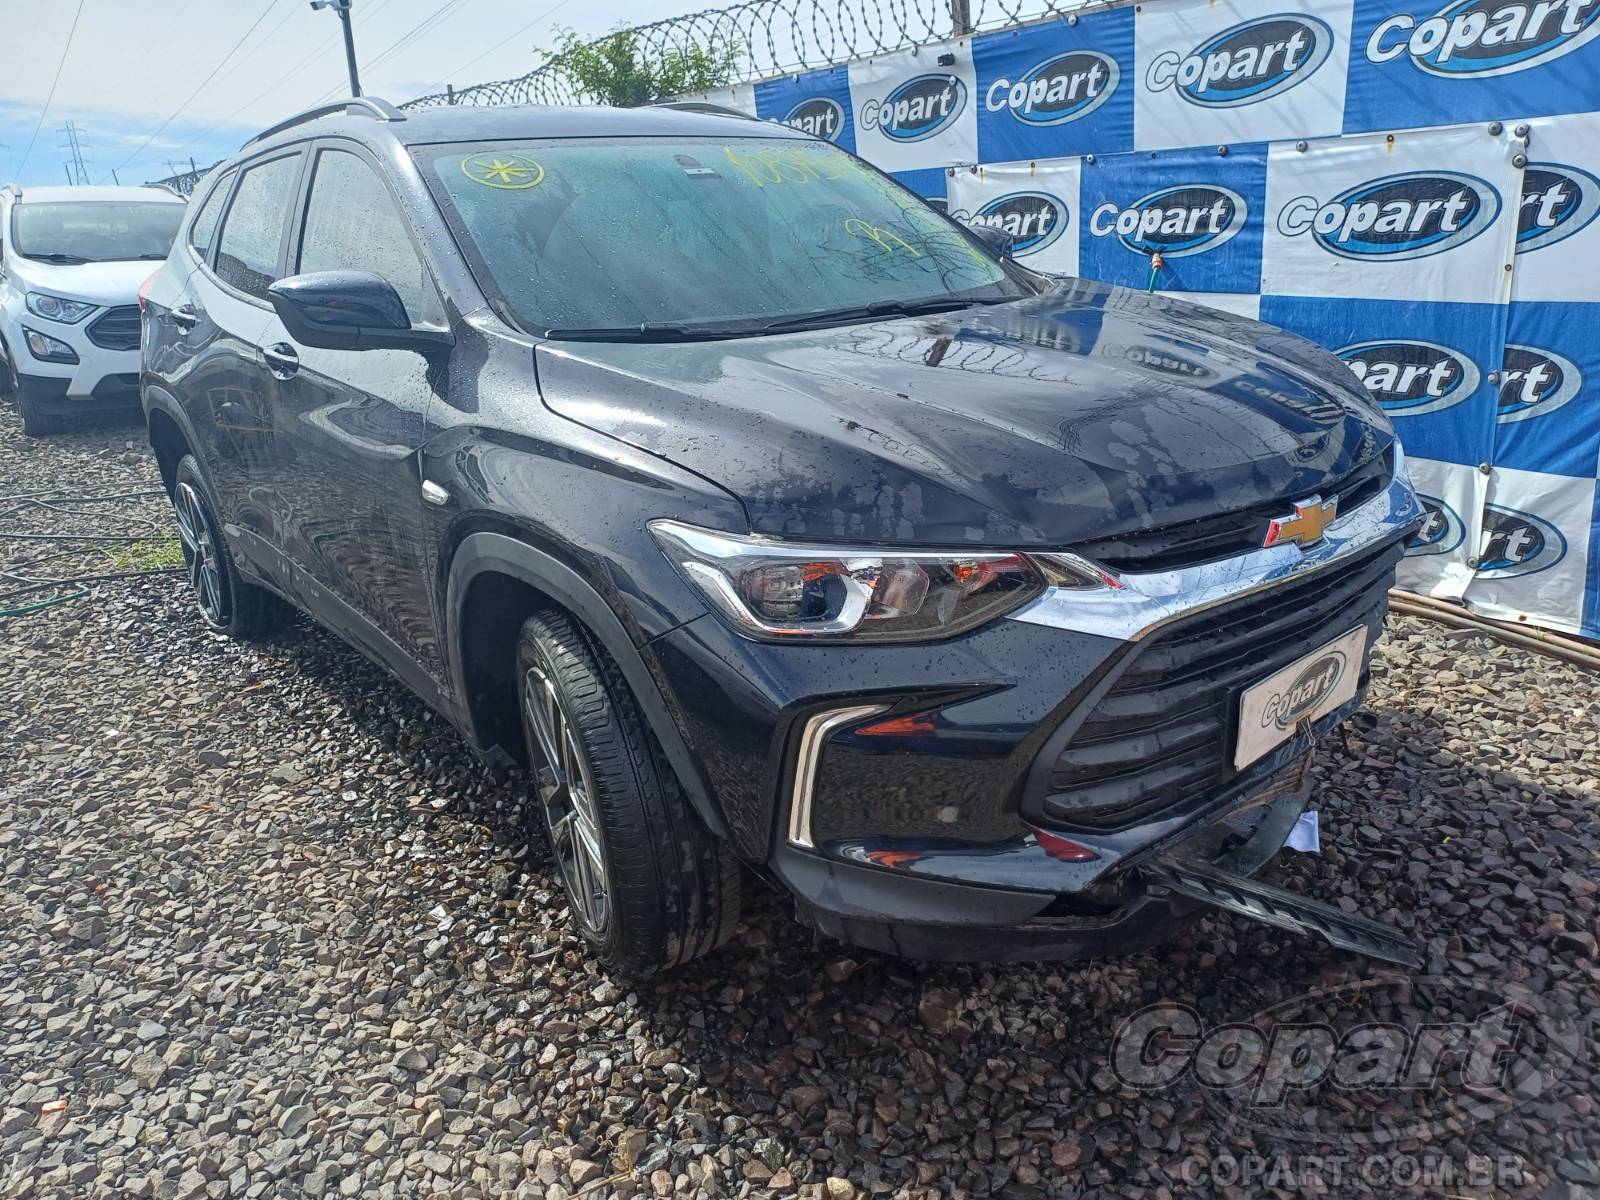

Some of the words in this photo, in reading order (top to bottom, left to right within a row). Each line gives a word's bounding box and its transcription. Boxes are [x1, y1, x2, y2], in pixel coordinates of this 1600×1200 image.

[1365, 0, 1595, 64] Copart
[1145, 26, 1306, 94] Copart
[860, 86, 951, 132] Copart
[986, 62, 1102, 114] Copart
[769, 106, 834, 136] part
[1090, 195, 1229, 243] Copart
[1277, 185, 1472, 243] Copart
[1341, 356, 1454, 397] part
[1261, 662, 1336, 729] Copart
